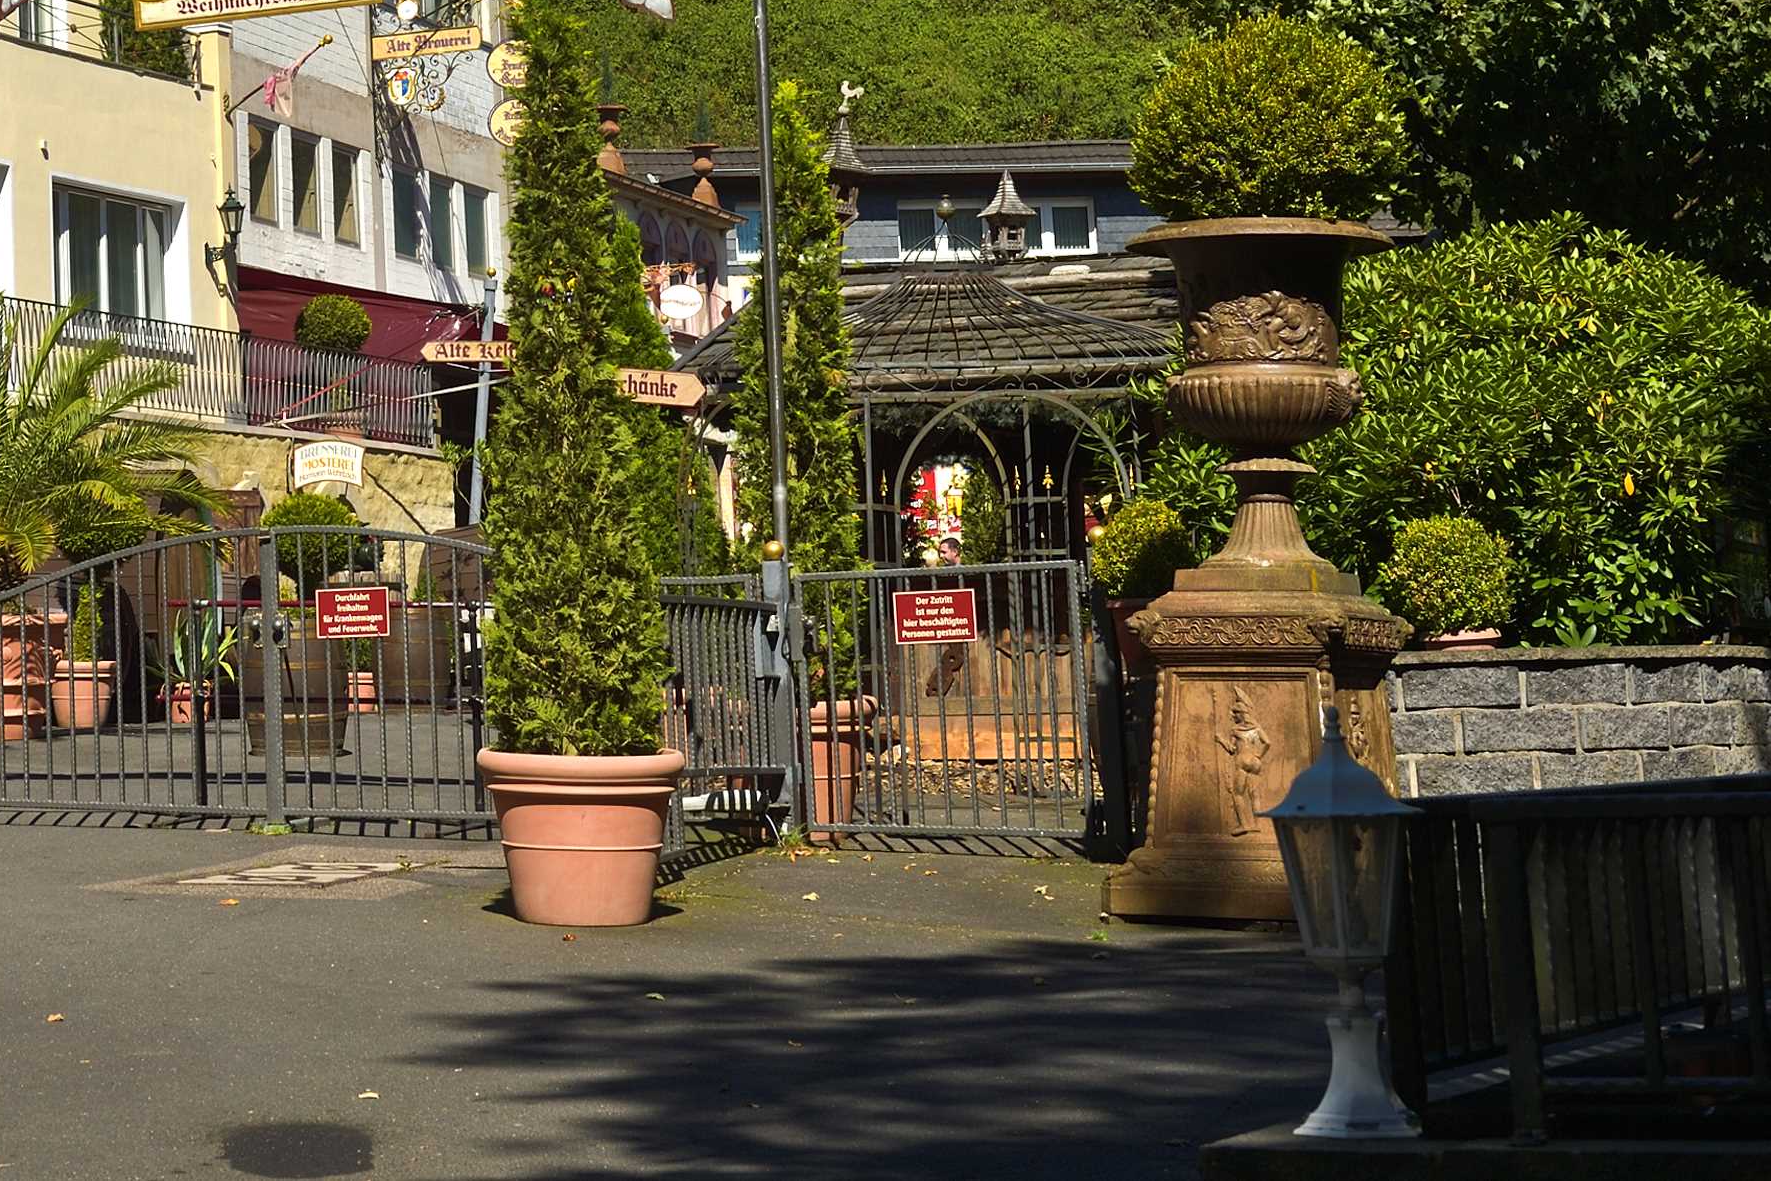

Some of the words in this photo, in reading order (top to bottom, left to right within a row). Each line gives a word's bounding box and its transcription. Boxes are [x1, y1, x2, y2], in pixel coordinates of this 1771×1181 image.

[387, 38, 411, 53] Alte
[414, 30, 471, 50] Brauerei
[435, 344, 471, 358] Alte
[477, 343, 517, 359] Kelt
[302, 458, 354, 471] MOSTEREI
[334, 593, 371, 602] Durchfahrt
[915, 597, 929, 605] Der
[930, 596, 953, 604] Zutritt
[336, 603, 369, 612] freihalten
[915, 608, 925, 616] ist
[323, 615, 333, 623] für
[334, 614, 383, 623] Krankenwagen
[903, 619, 918, 627] hier
[919, 617, 968, 627] beschäftigten
[328, 625, 341, 633] und
[901, 630, 935, 638] Personen
[936, 628, 971, 638] gestattet.
